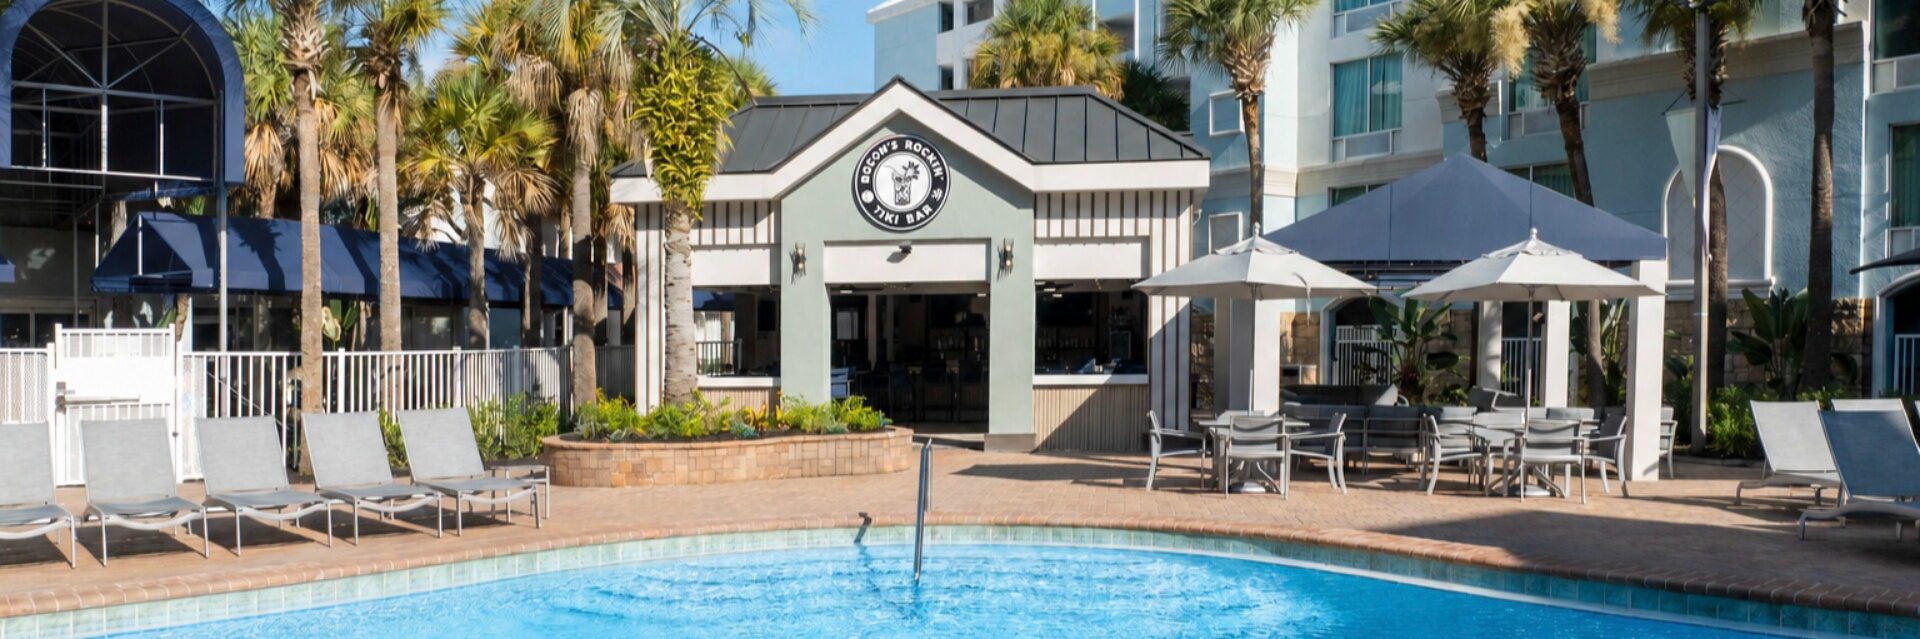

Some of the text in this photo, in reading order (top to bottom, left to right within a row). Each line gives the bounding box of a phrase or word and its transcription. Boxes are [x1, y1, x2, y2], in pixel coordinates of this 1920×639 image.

[905, 140, 944, 181] ROCKIN'
[873, 204, 932, 224] TIKI BAR
